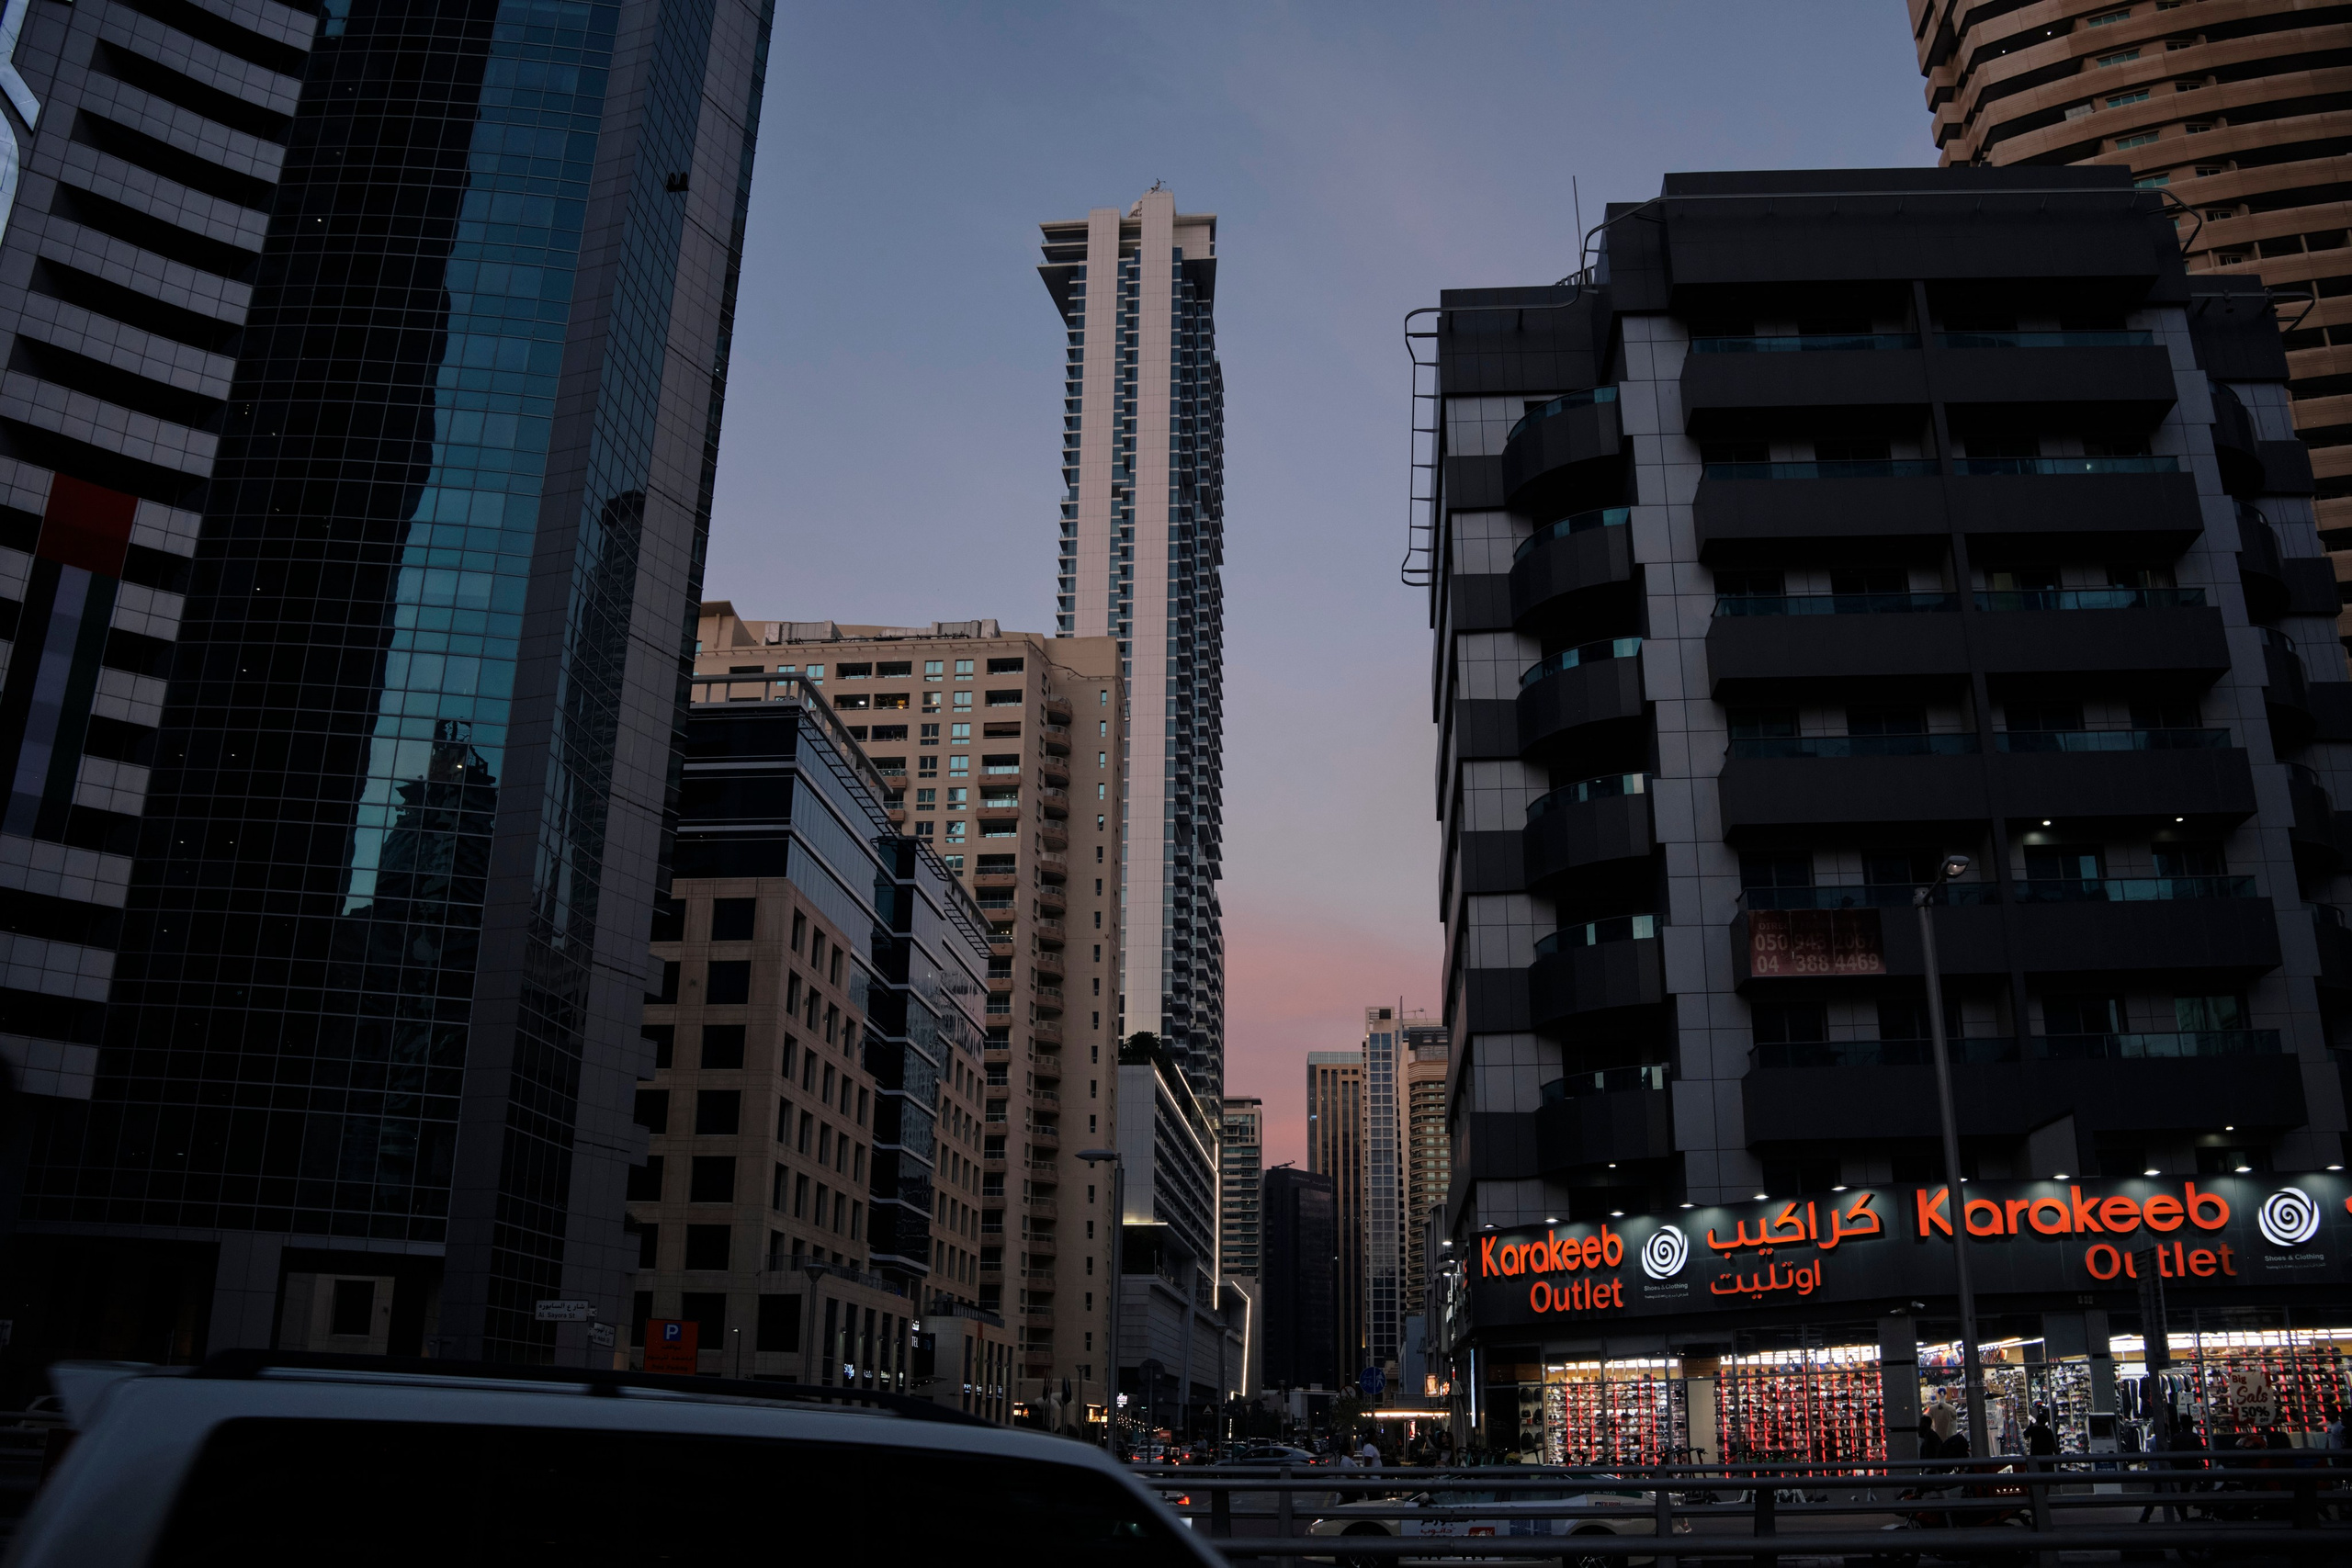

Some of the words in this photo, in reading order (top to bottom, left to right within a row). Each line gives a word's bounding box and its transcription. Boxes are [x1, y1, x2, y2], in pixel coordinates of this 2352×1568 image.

[1755, 933, 1788, 952] 050
[1794, 932, 1826, 951] 943
[1834, 931, 1876, 950] 2067
[1757, 954, 1780, 973] 04
[1795, 954, 1829, 973] 388
[1835, 953, 1880, 972] 4469
[1917, 1181, 2231, 1237] Karakeeb
[1707, 1193, 1881, 1260] كراكيب
[1480, 1224, 1624, 1278] Karakeeb
[2294, 1253, 2324, 1261] Clothing
[1710, 1258, 1822, 1301] اوتليت
[1530, 1277, 1625, 1314] Outlet
[665, 1324, 679, 1340] P
[2232, 1375, 2246, 1384] Big
[2241, 1406, 2270, 1417] 50%
